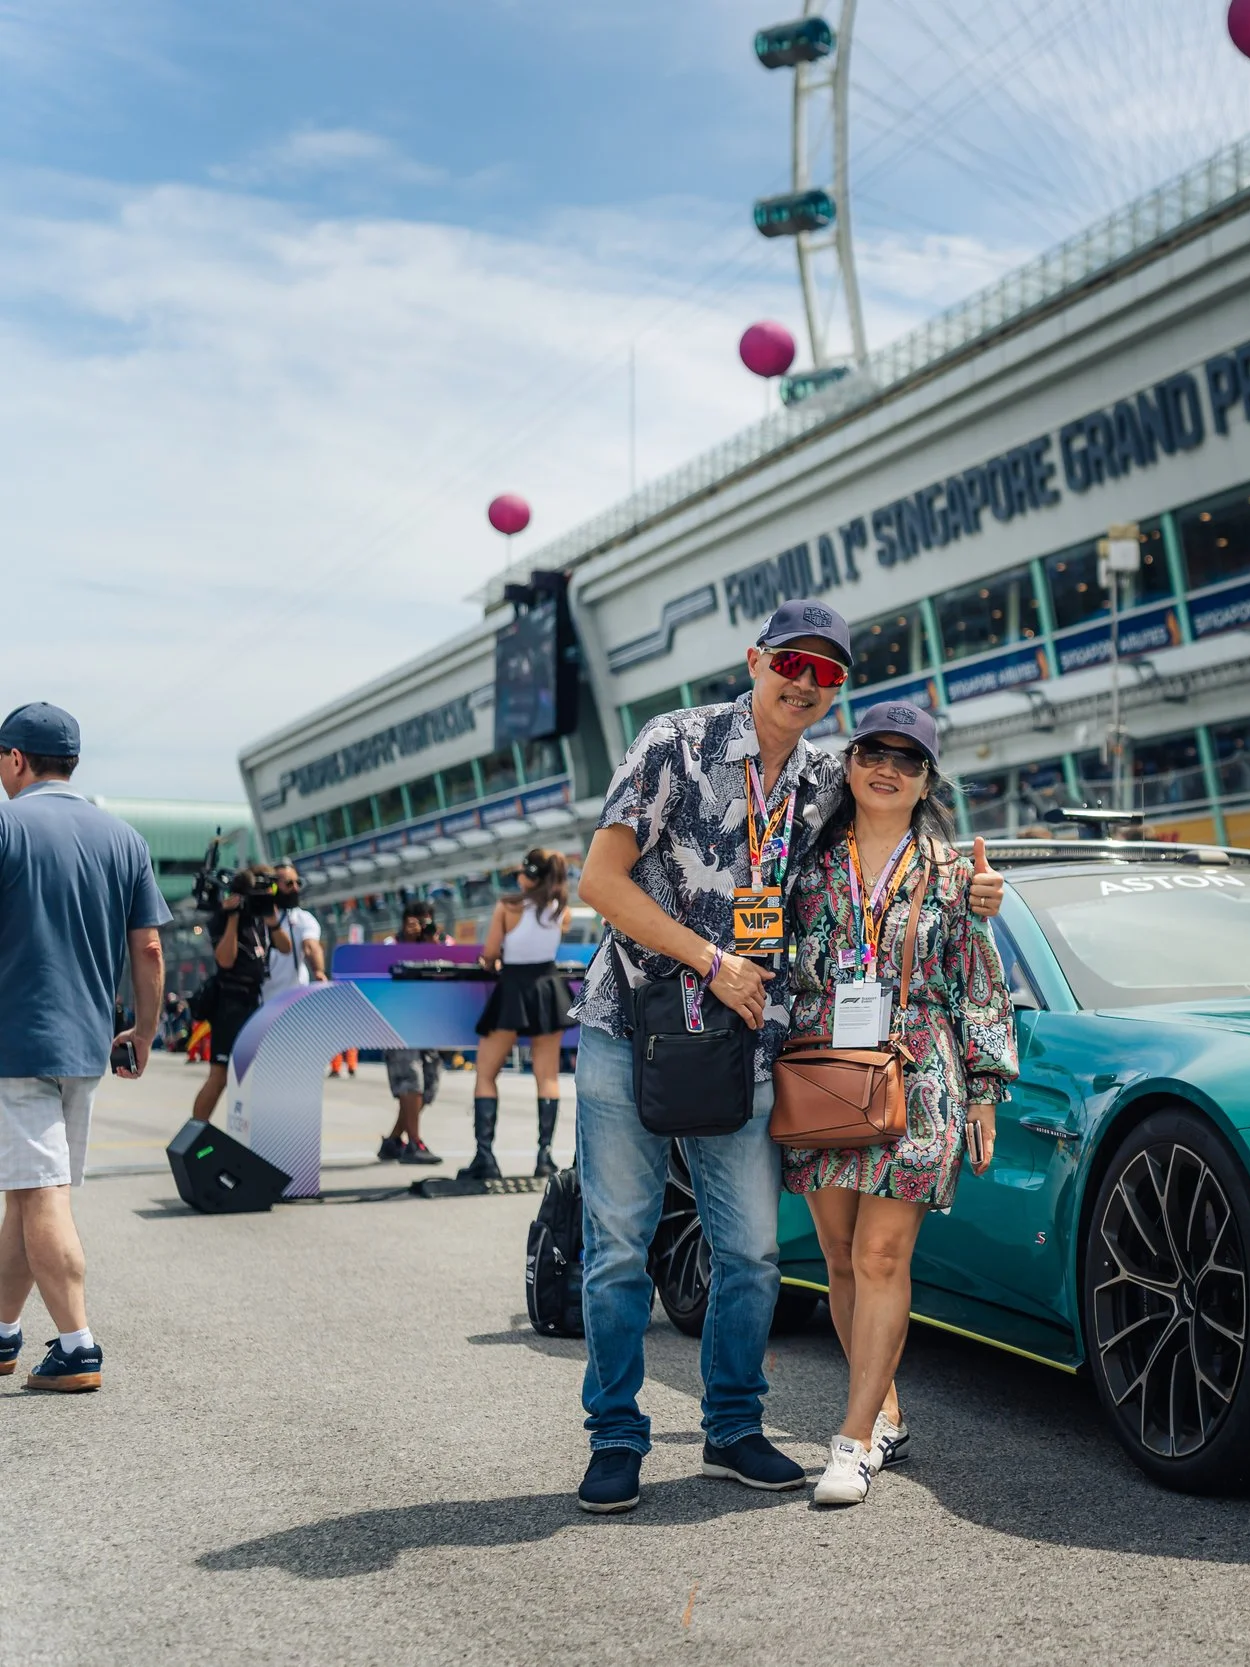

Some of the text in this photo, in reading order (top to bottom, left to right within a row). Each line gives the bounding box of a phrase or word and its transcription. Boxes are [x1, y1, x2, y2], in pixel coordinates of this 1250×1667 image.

[724, 533, 842, 626] FORMULA
[872, 433, 1061, 569] SINGAPORE
[1060, 372, 1202, 494] GRAND
[1100, 873, 1245, 896] ASTON
[739, 912, 780, 929] VIP
